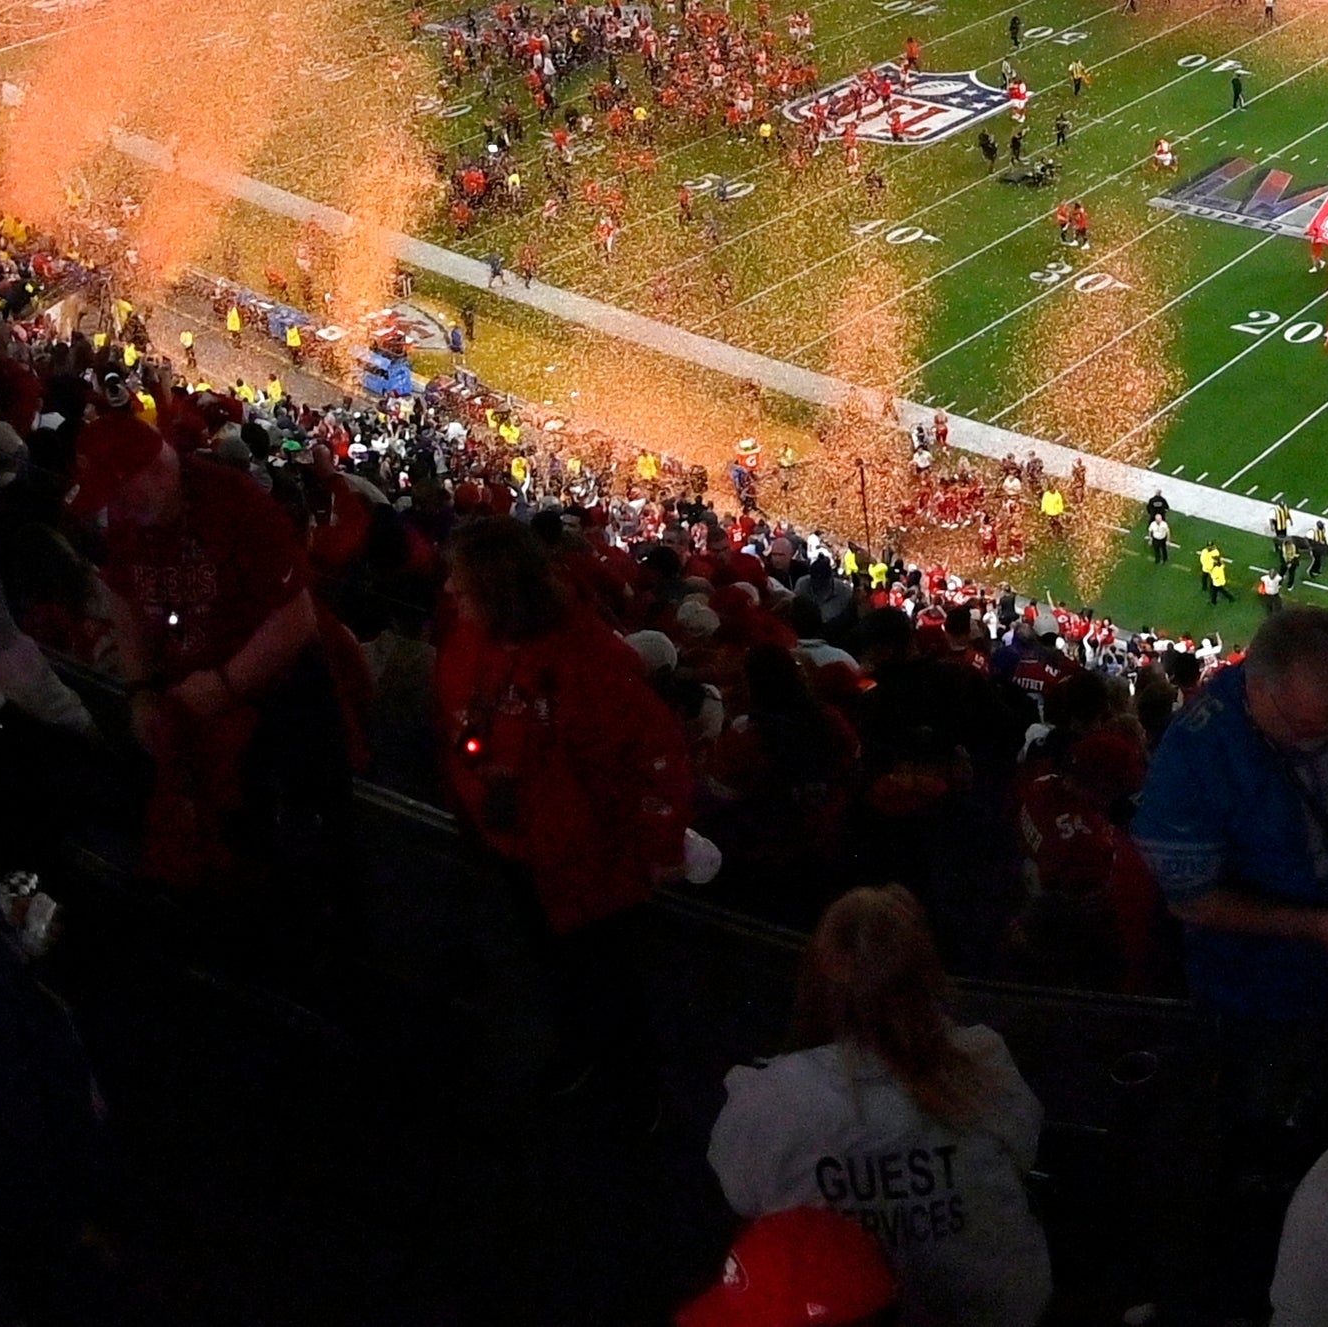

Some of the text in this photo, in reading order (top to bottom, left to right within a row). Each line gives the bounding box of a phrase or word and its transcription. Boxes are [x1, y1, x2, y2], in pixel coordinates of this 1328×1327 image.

[1029, 262, 1115, 292] 30
[1230, 310, 1325, 344] 20
[815, 1145, 957, 1203] GUEST
